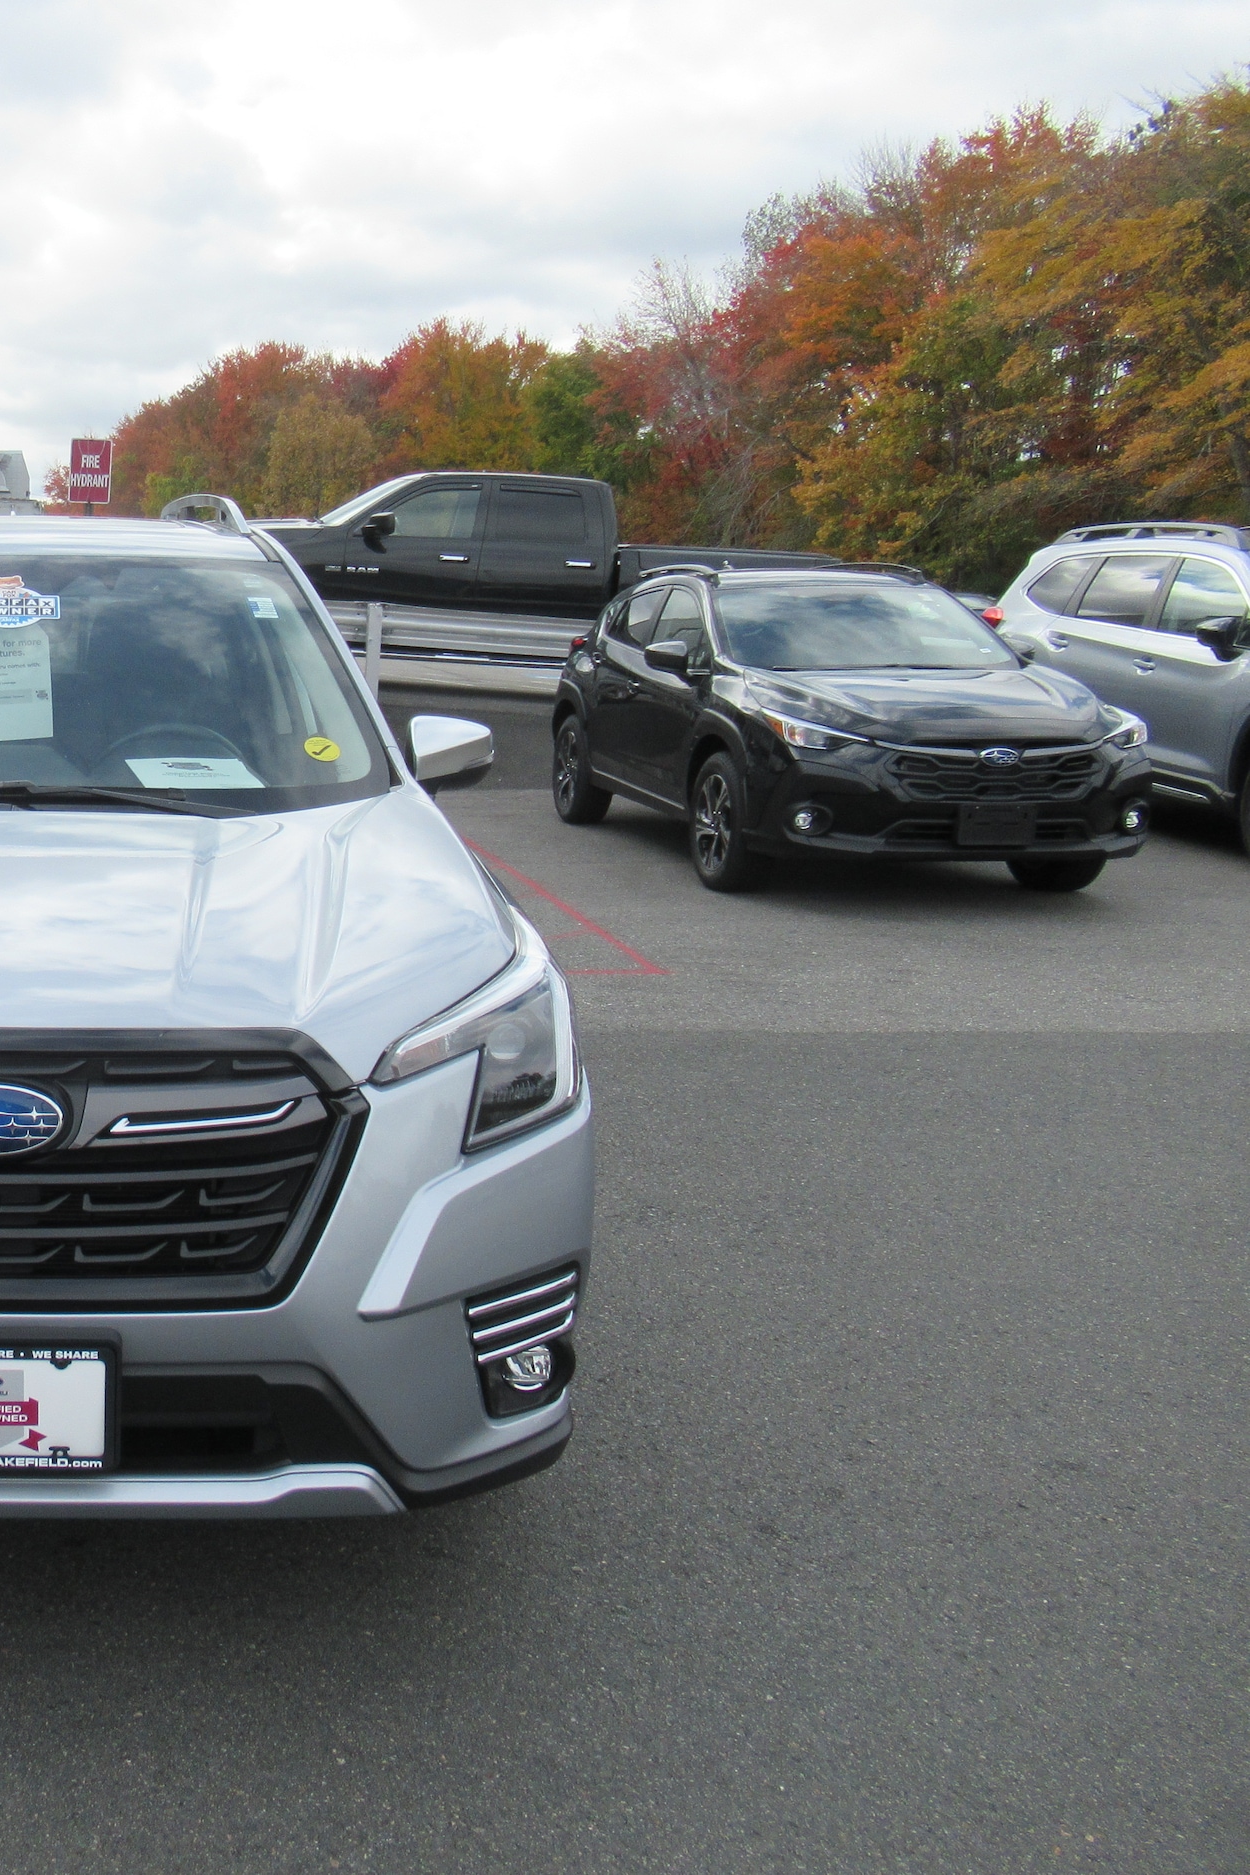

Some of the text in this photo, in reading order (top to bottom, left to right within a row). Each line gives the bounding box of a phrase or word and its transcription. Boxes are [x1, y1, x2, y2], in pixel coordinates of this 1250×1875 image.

[81, 454, 100, 468] FIRE
[70, 473, 109, 487] HYDRANT
[3, 640, 16, 648] for
[32, 1350, 52, 1359] WE
[55, 1351, 99, 1359] SHARE
